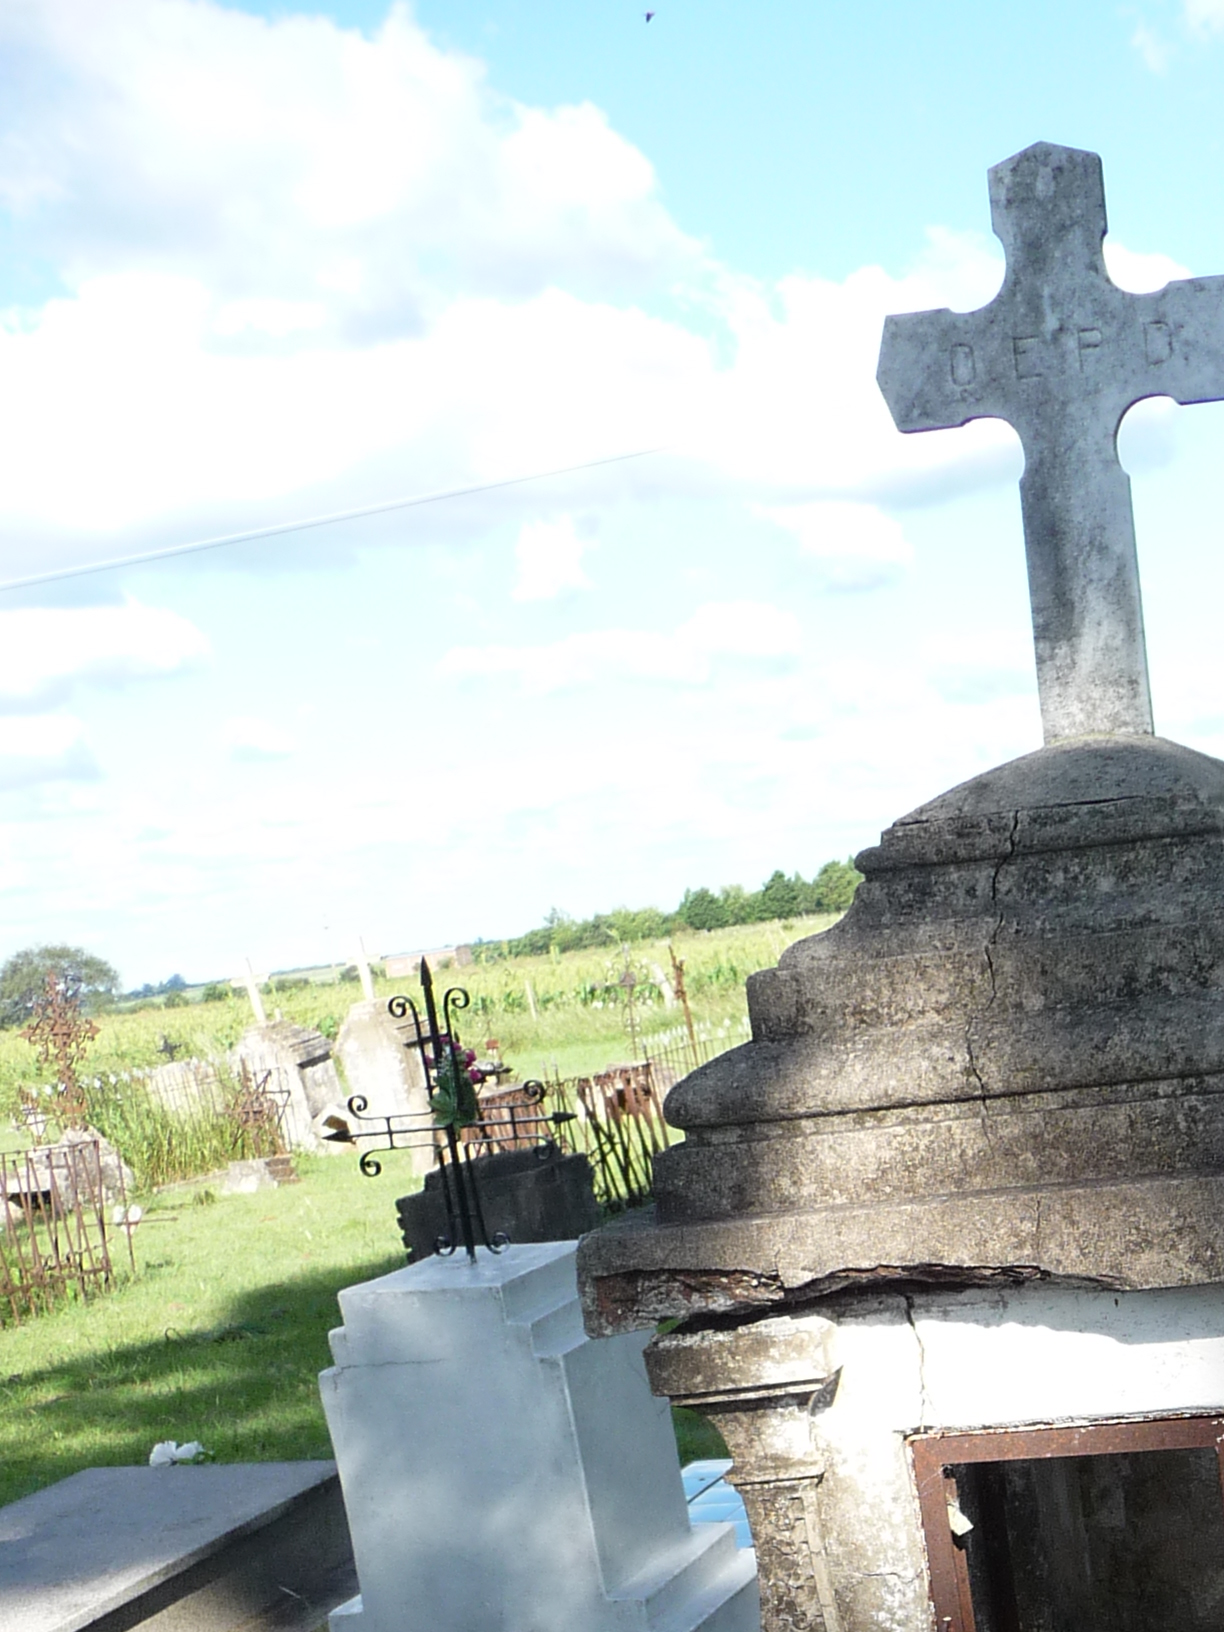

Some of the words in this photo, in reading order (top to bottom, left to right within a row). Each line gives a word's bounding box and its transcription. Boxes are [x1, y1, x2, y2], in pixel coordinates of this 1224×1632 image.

[1012, 334, 1043, 381] E
[1078, 327, 1102, 373] P
[1142, 319, 1174, 366] D
